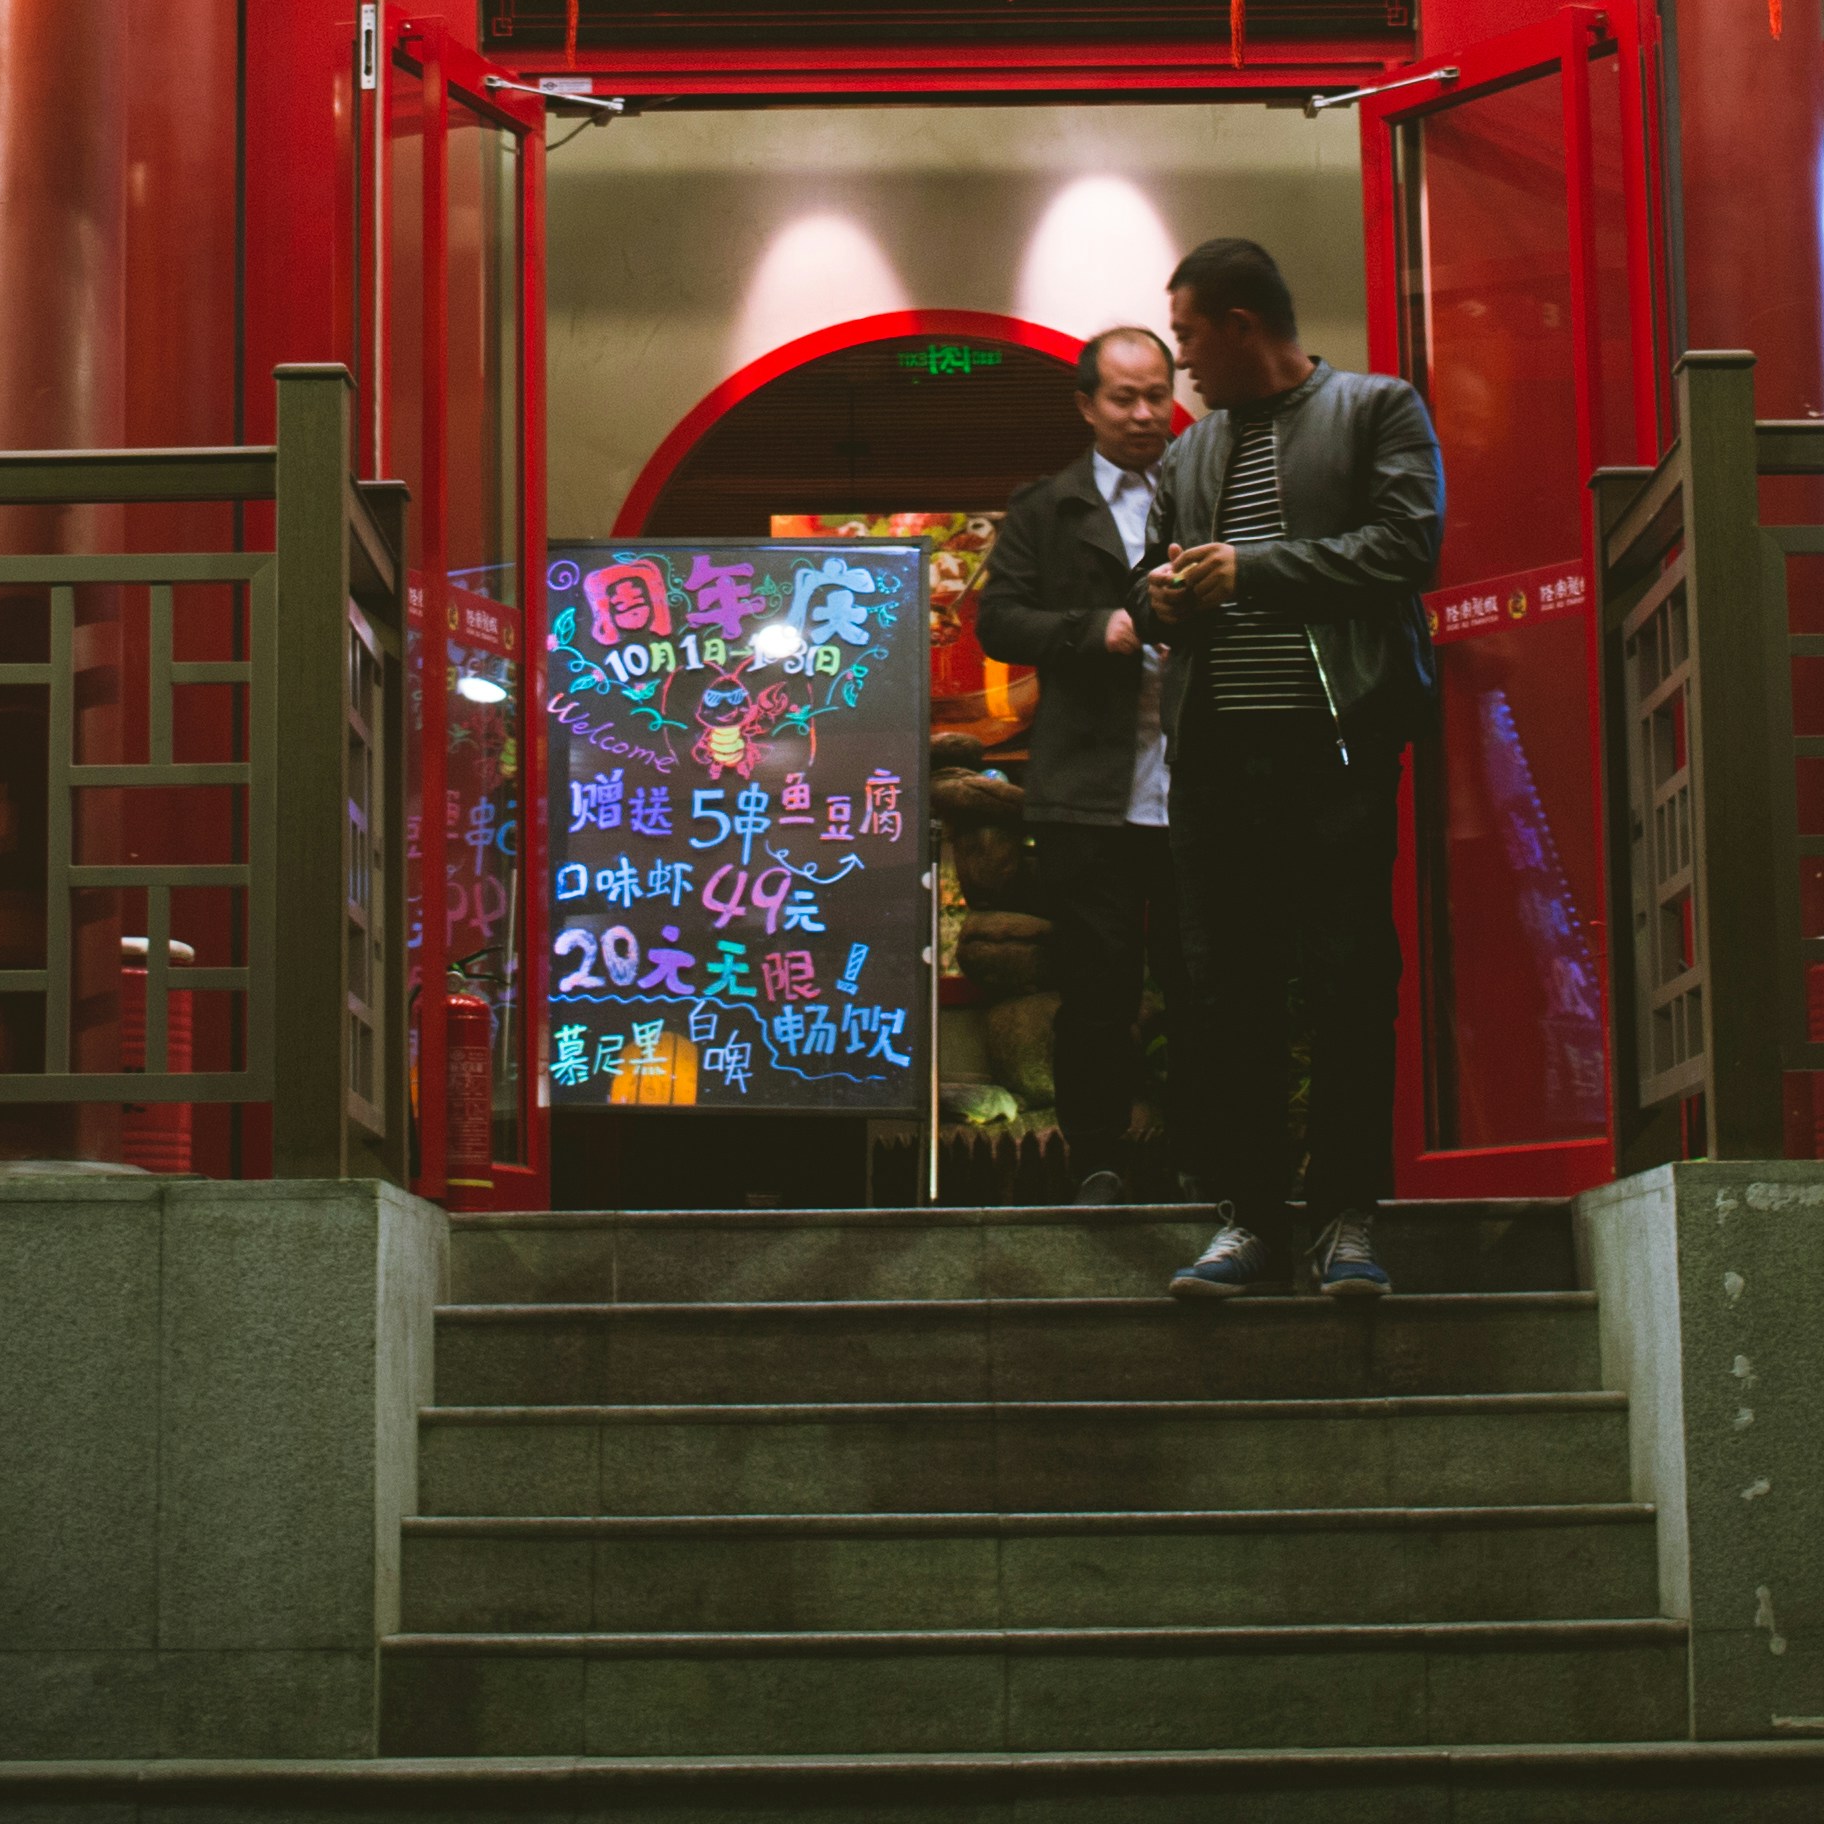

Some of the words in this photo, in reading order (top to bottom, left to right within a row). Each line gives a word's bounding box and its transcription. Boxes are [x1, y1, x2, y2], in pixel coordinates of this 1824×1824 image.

[583, 555, 877, 647] 周年庆
[547, 692, 674, 774] Welcome
[772, 1003, 911, 1068] 畅饮
